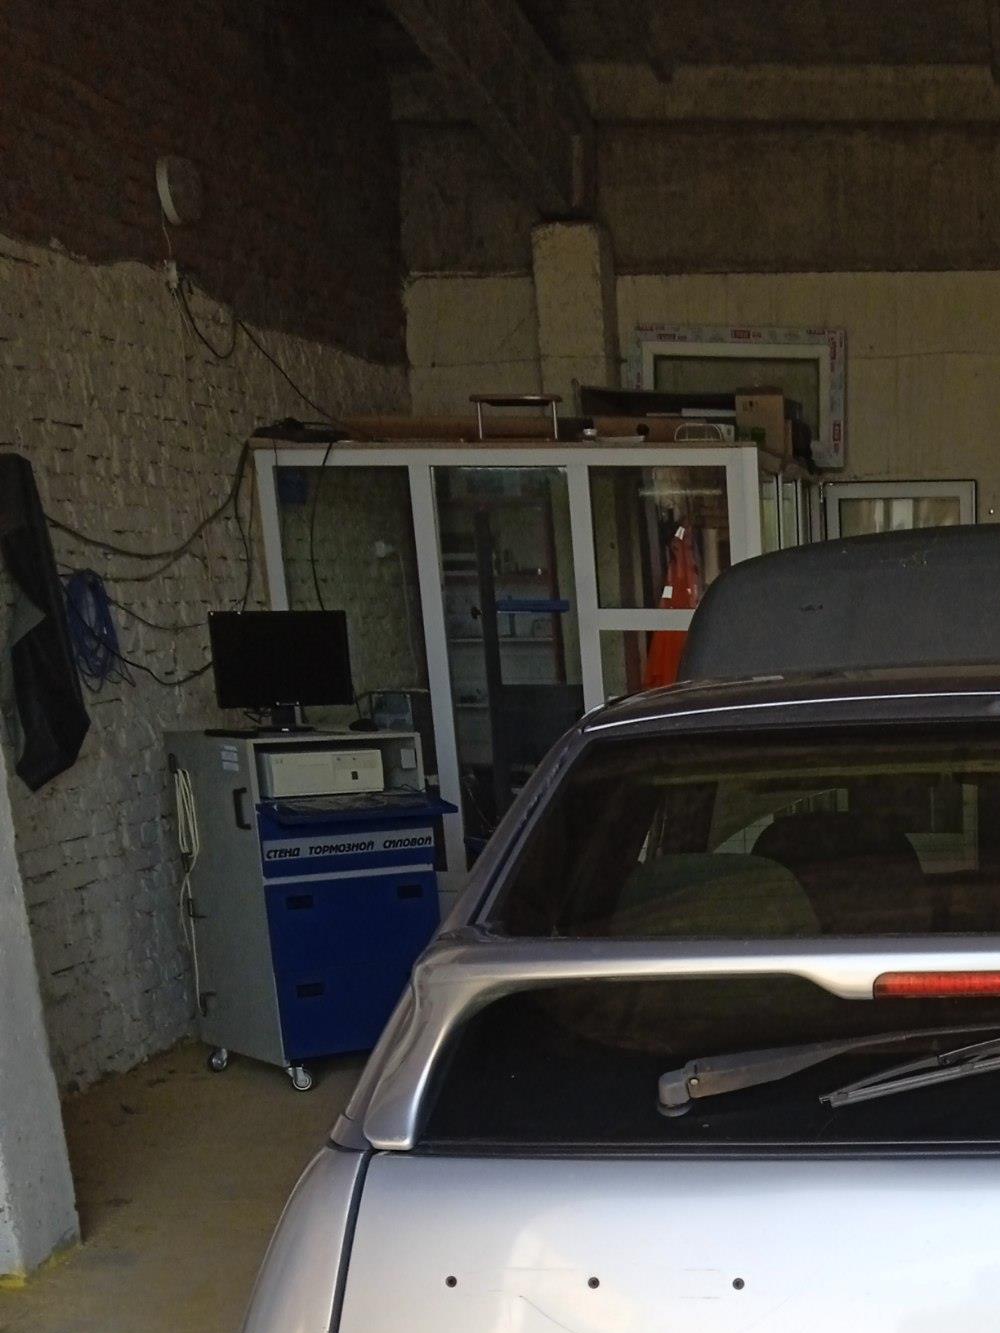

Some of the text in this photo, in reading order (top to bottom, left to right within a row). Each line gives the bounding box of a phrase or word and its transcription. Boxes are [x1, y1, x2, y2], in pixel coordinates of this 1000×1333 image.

[266, 836, 432, 859] СТЕНД ТОРМОЗНОЙ СИЛОВОЙ
